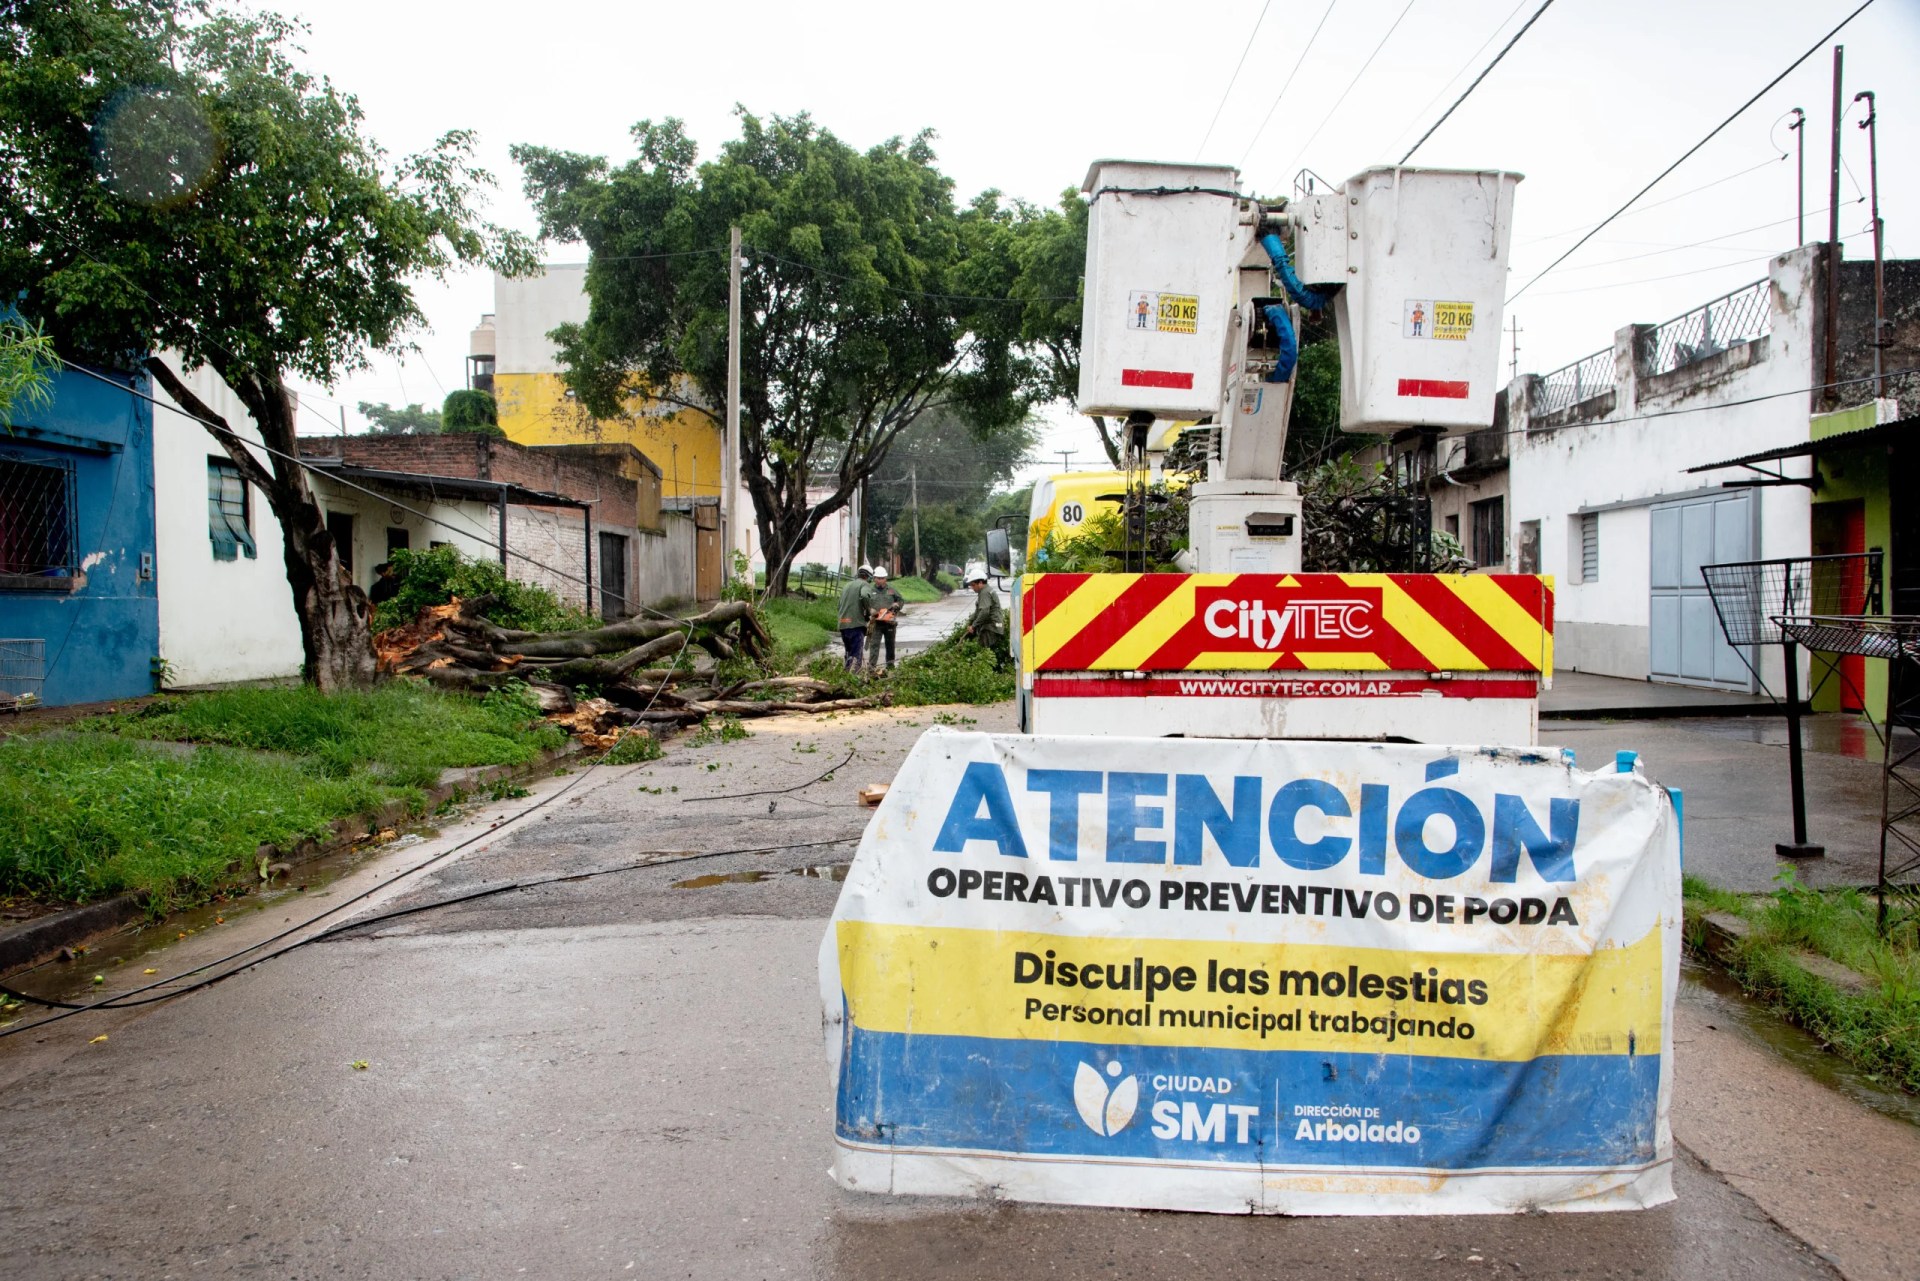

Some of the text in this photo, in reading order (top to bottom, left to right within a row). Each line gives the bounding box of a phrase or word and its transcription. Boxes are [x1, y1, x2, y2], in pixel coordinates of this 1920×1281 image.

[1160, 303, 1197, 320] 120 KG
[1435, 311, 1473, 326] 120 KG
[1062, 504, 1083, 523] 80
[1179, 681, 1392, 696] WWW.CITYTEC.COM.AR
[932, 756, 1580, 883] ATENCIÓN
[927, 867, 1580, 926] OPERATIVO PREVENTIVO DE PODA
[1013, 950, 1490, 1006] Disculpe las molestias
[1024, 998, 1476, 1043] Personal municipal trabajando
[1152, 1074, 1232, 1094] CIUDAD
[1151, 1100, 1260, 1145] SMT
[1294, 1103, 1381, 1119] DIRECCIÓN DE
[1294, 1118, 1421, 1145] Arbolado
